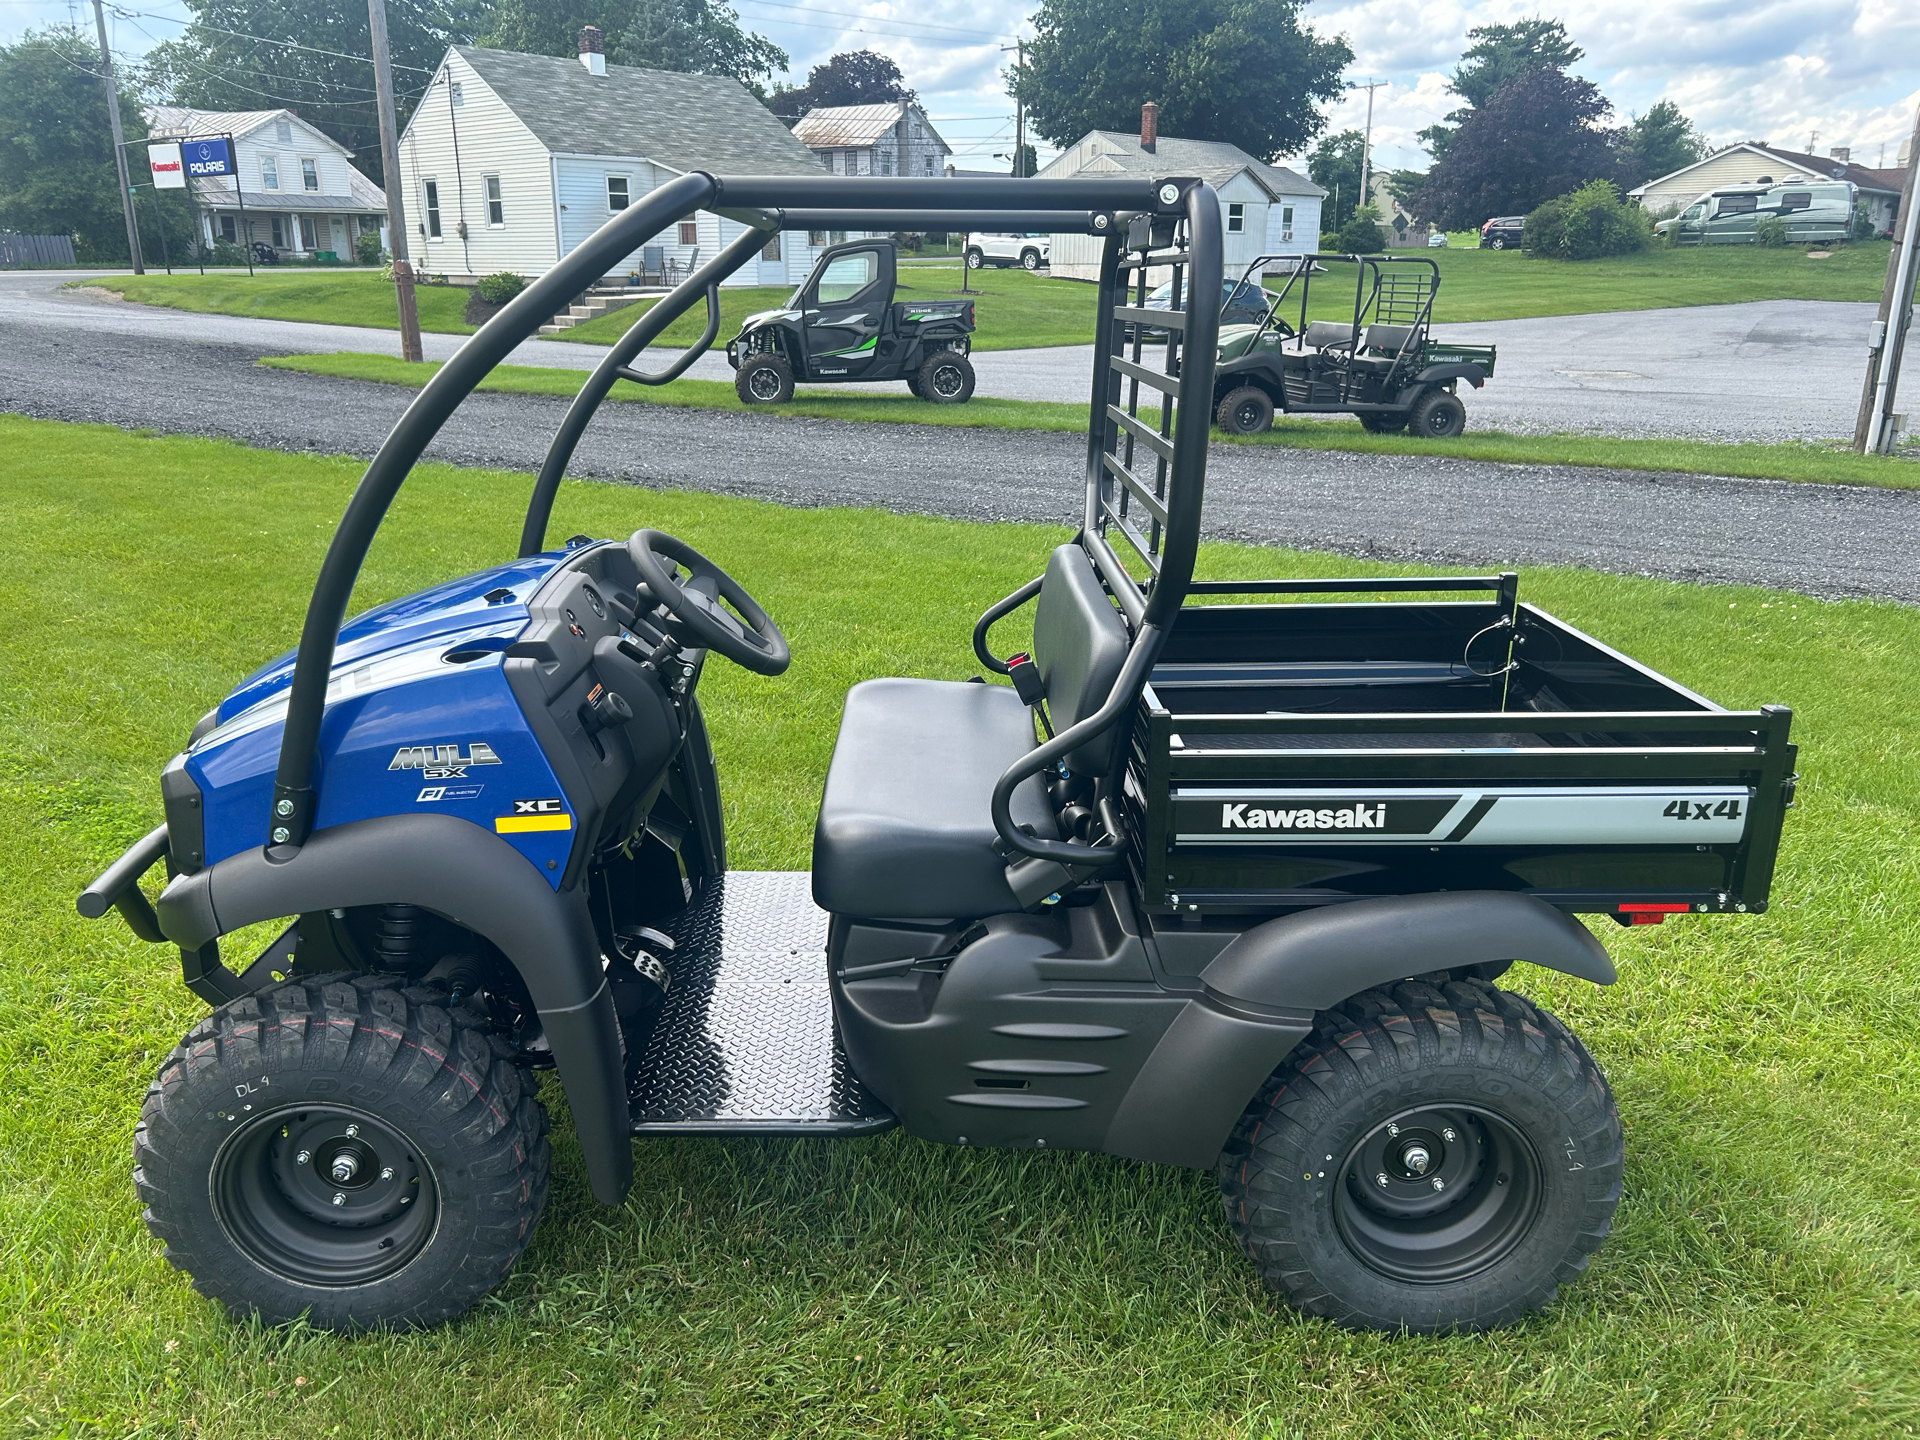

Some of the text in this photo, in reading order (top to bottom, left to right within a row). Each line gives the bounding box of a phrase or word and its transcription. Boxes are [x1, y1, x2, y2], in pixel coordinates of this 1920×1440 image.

[164, 128, 171, 136] &
[172, 127, 186, 136] Son
[152, 161, 180, 172] Kawasaki
[189, 161, 225, 174] POLARIS
[1429, 355, 1463, 363] Kawasaki
[388, 743, 502, 771] MULE
[423, 767, 469, 780] SX
[420, 789, 441, 799] FI
[514, 800, 561, 813] XC
[1663, 800, 1743, 820] 4x4
[1222, 803, 1387, 829] Kawasaki
[304, 1076, 447, 1149] DURO
